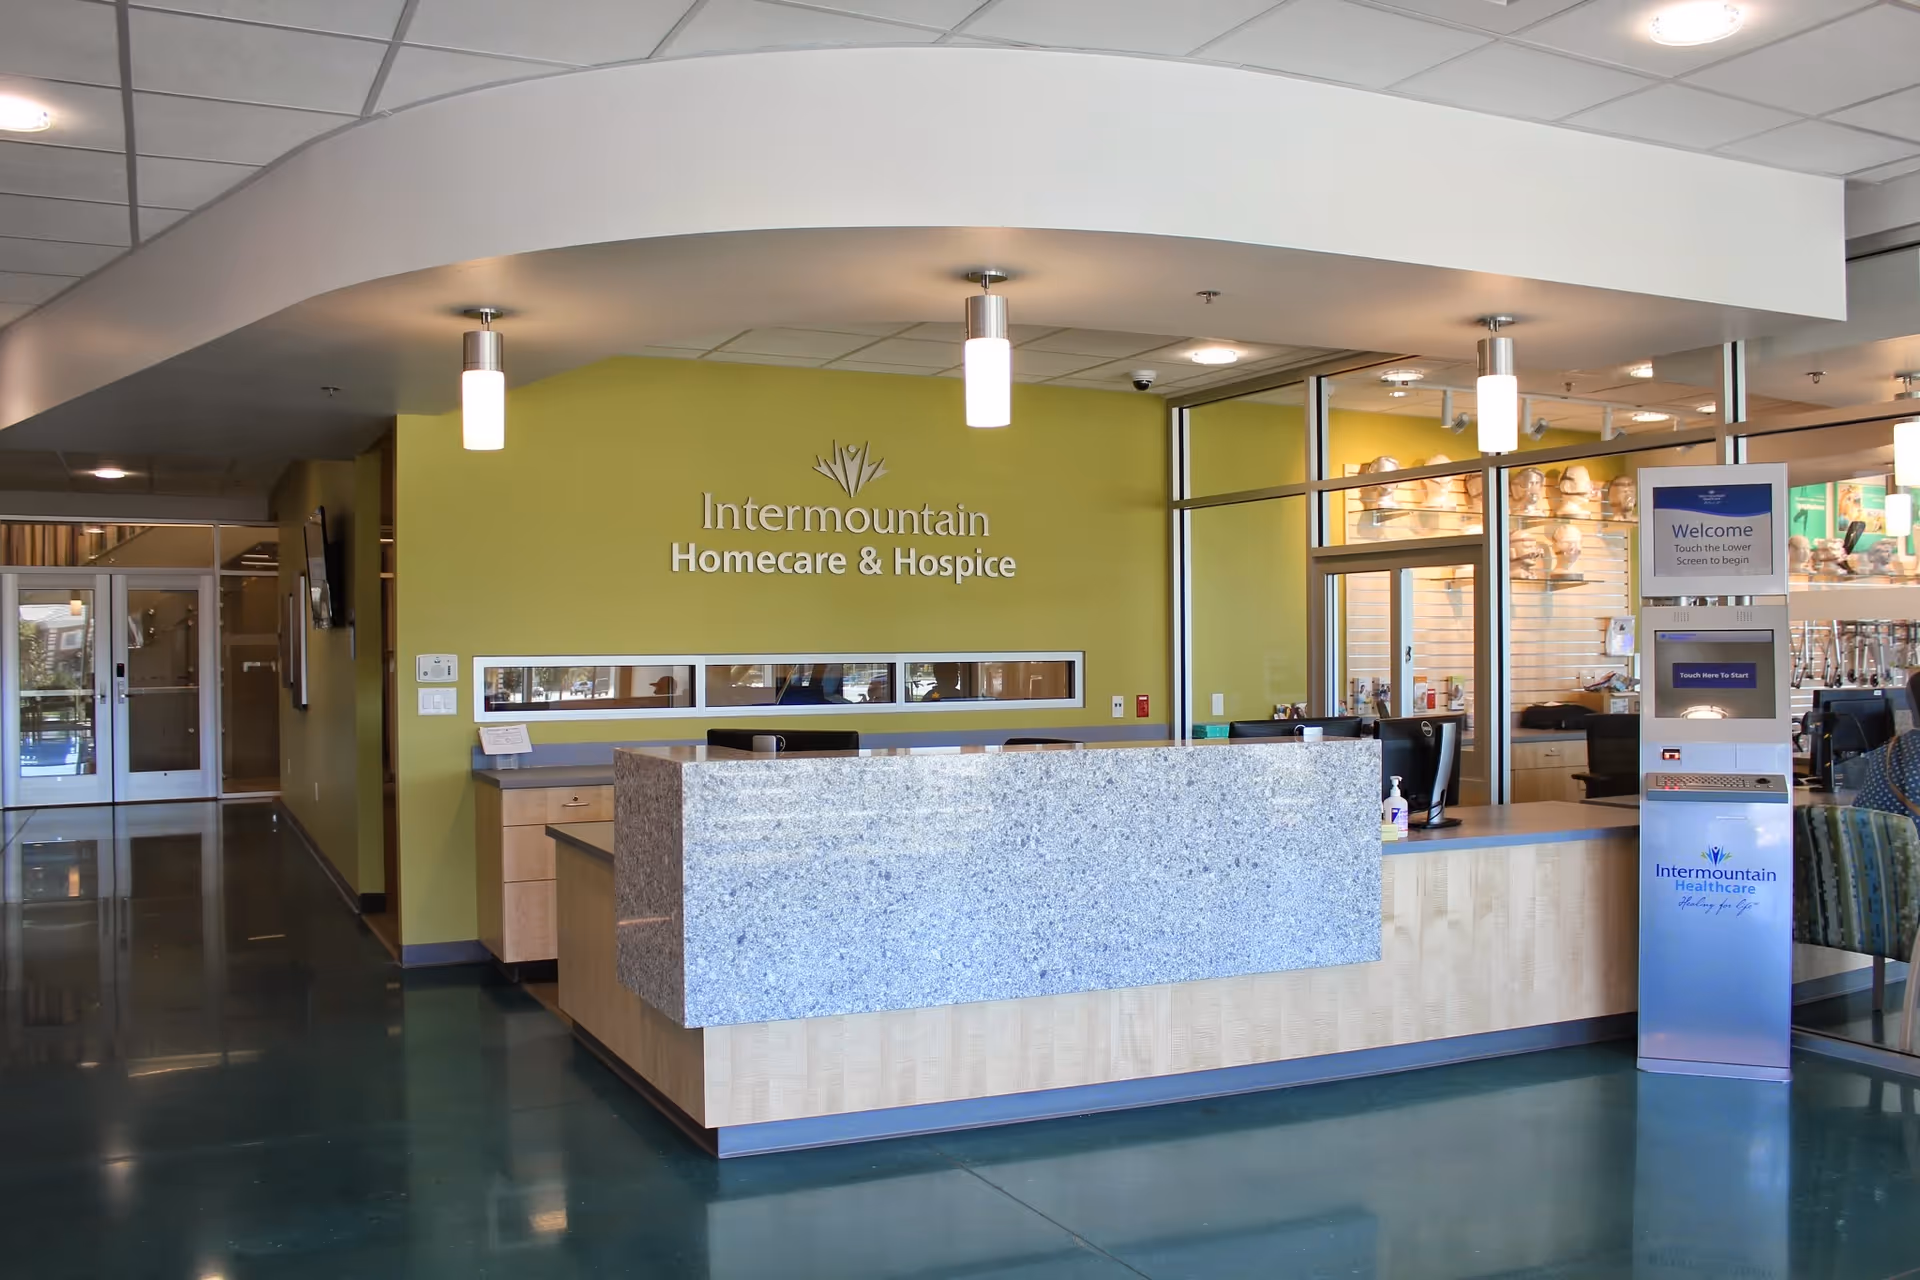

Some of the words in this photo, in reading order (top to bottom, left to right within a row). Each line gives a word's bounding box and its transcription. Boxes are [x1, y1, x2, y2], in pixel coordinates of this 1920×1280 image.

[701, 492, 990, 537] Intermountain
[1671, 523, 1753, 539] Welcome
[1674, 544, 1702, 553] Touch
[1704, 543, 1720, 552] the
[1722, 543, 1752, 552] Lower
[670, 542, 847, 575] Homecare
[858, 546, 884, 576] &
[895, 547, 1016, 584] Hospice
[1676, 556, 1708, 565] Screen
[1710, 556, 1720, 565] to
[1722, 555, 1749, 567] begin
[1656, 864, 1776, 881] Intermountain
[1675, 880, 1756, 895] Healthcare
[1678, 896, 1716, 914] Healing
[1716, 898, 1731, 916] for
